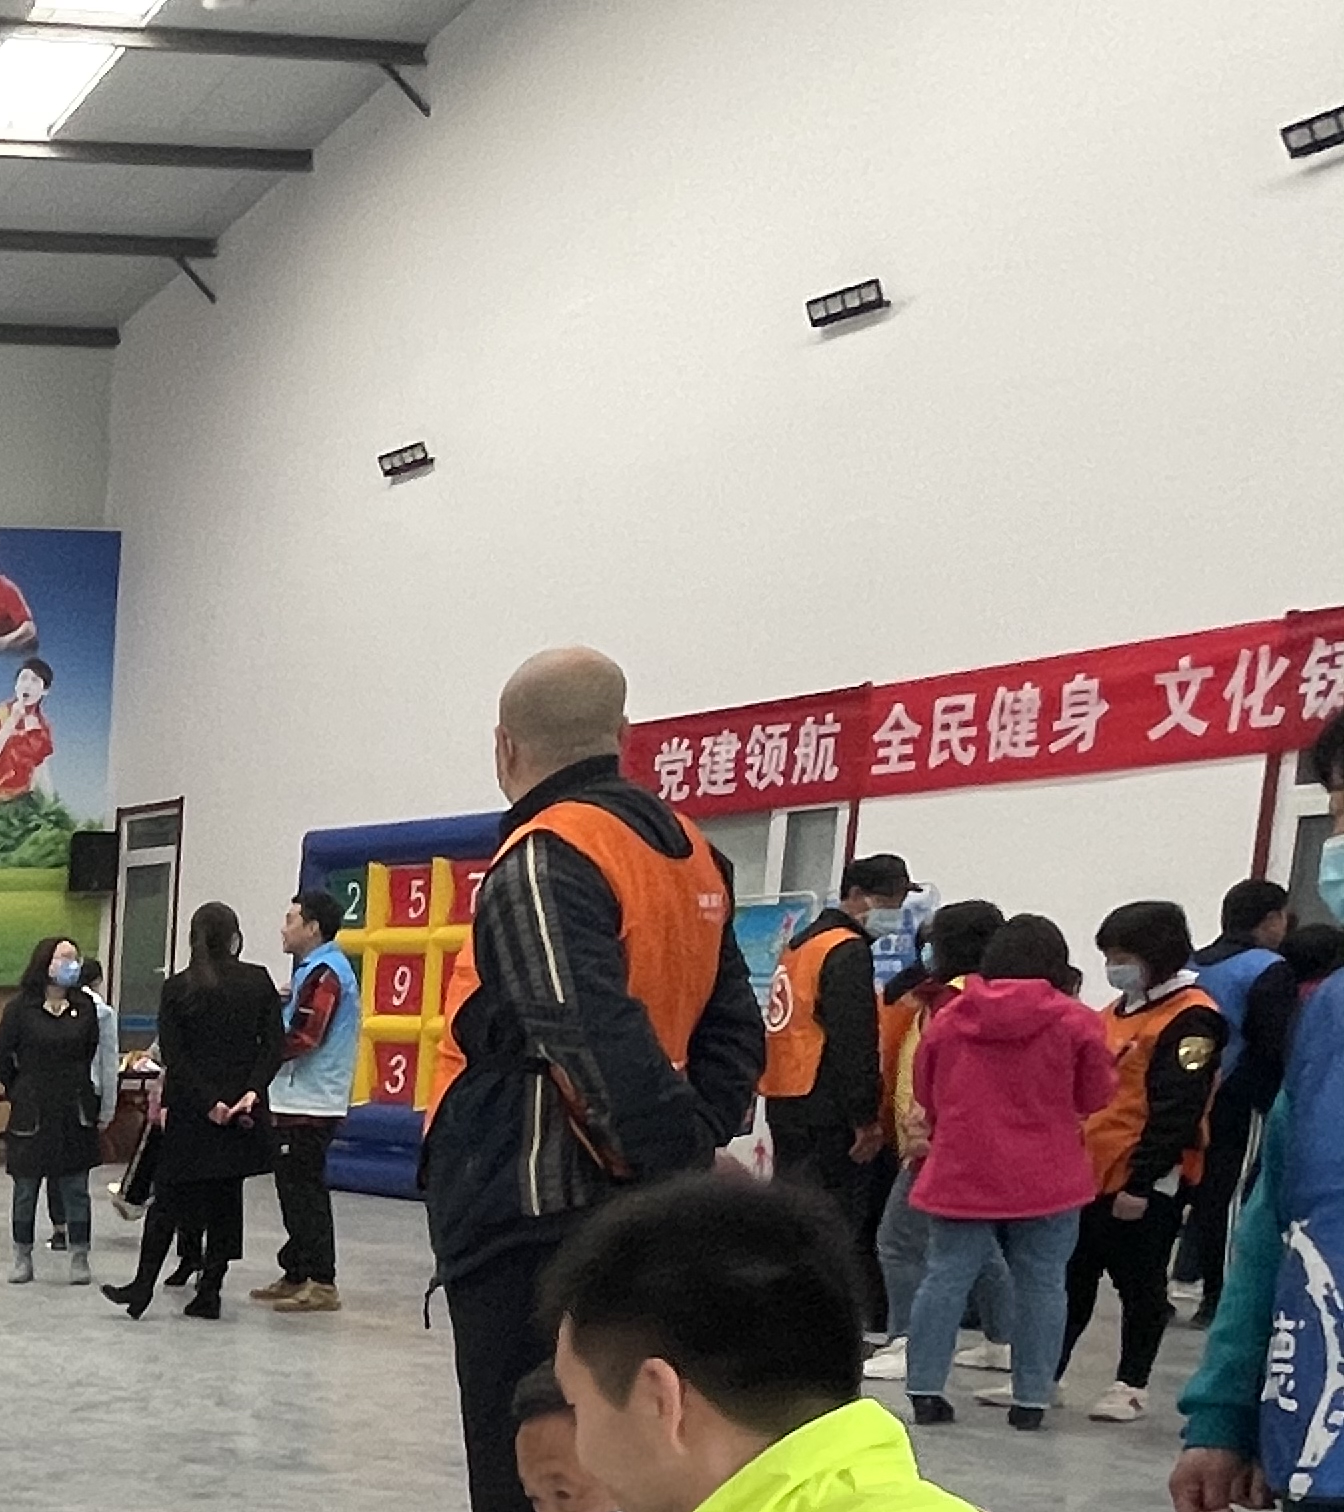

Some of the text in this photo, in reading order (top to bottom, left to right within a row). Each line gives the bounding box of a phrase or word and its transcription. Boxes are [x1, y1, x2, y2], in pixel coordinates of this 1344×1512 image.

[653, 711, 841, 801] 党建领航
[870, 672, 1109, 776] 全民健身
[343, 872, 485, 920] 2 5 7
[392, 965, 412, 1006] 9
[385, 1054, 407, 1094] 3
